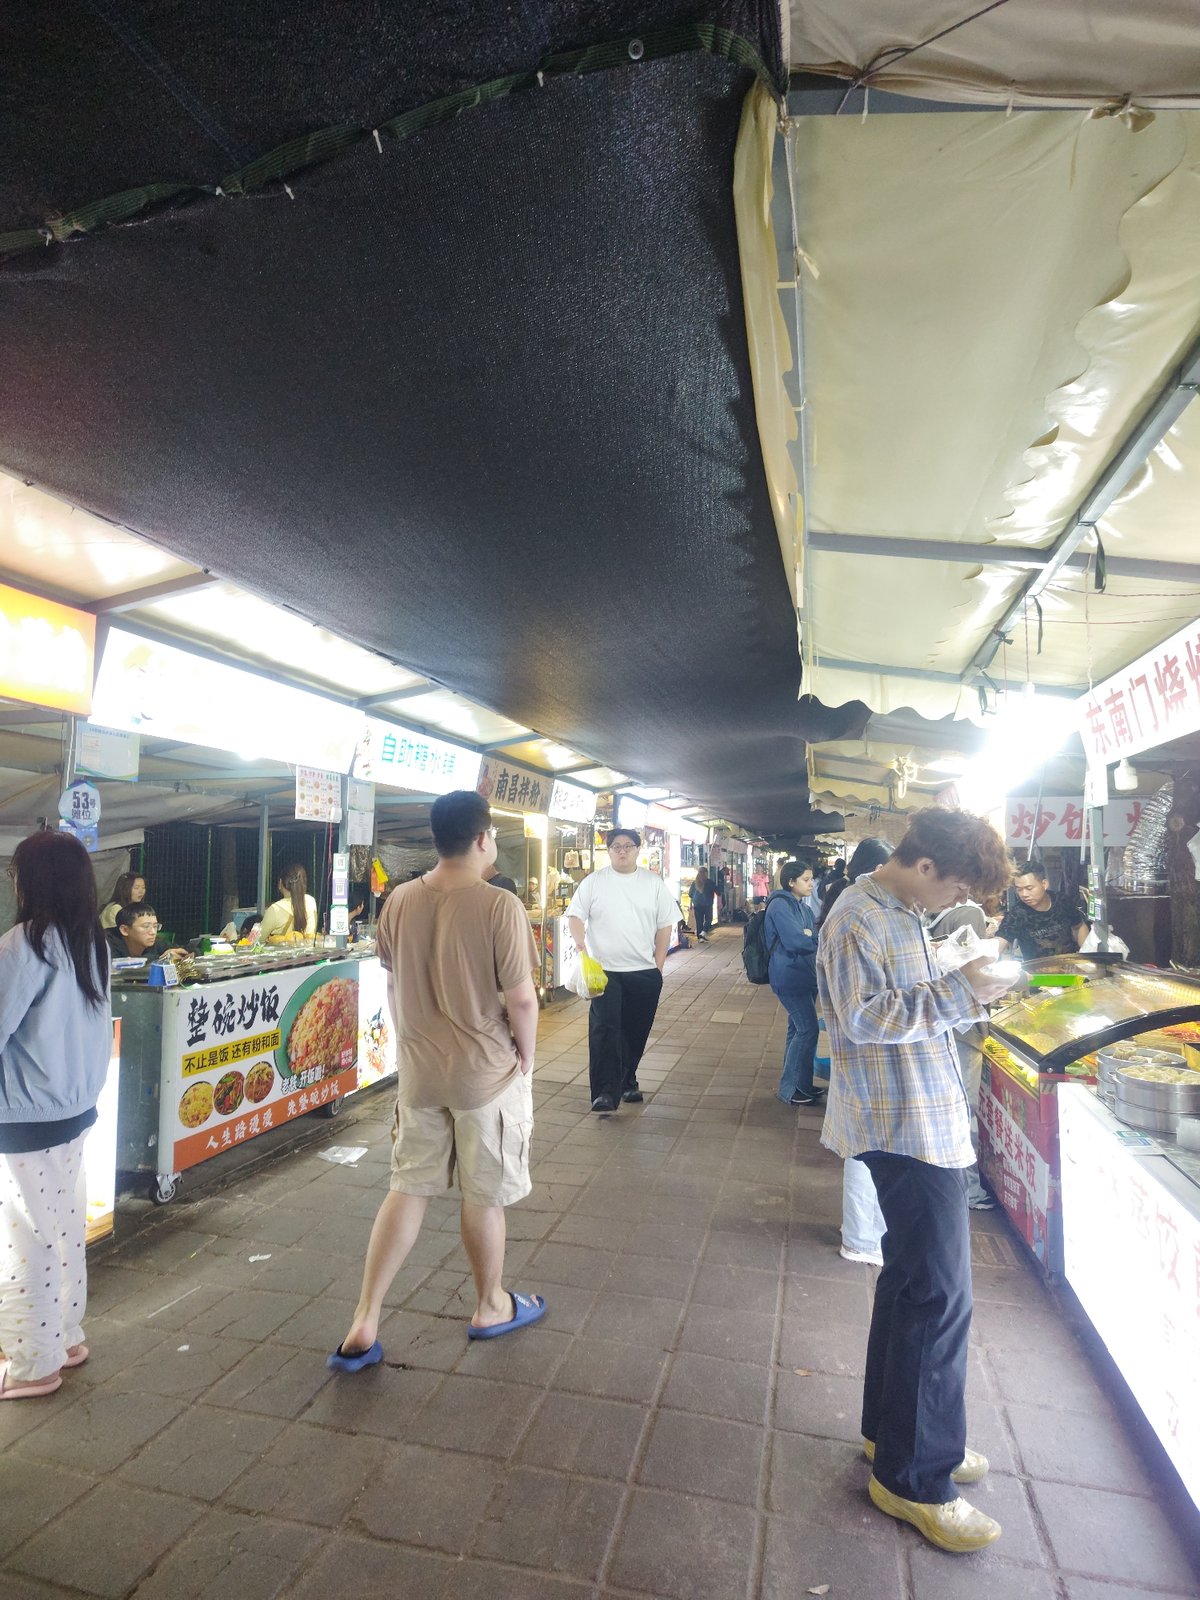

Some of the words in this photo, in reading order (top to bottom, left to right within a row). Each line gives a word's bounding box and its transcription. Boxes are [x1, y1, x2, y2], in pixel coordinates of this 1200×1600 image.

[495, 768, 540, 807] 南昌拌粉
[187, 984, 279, 1047] 整碗炒饭
[184, 1046, 229, 1073] 不止是饭
[231, 1032, 279, 1060] 还有粉和面
[206, 1107, 274, 1150] 人生路漫漫
[286, 1079, 340, 1118] 先整碗炒饭
